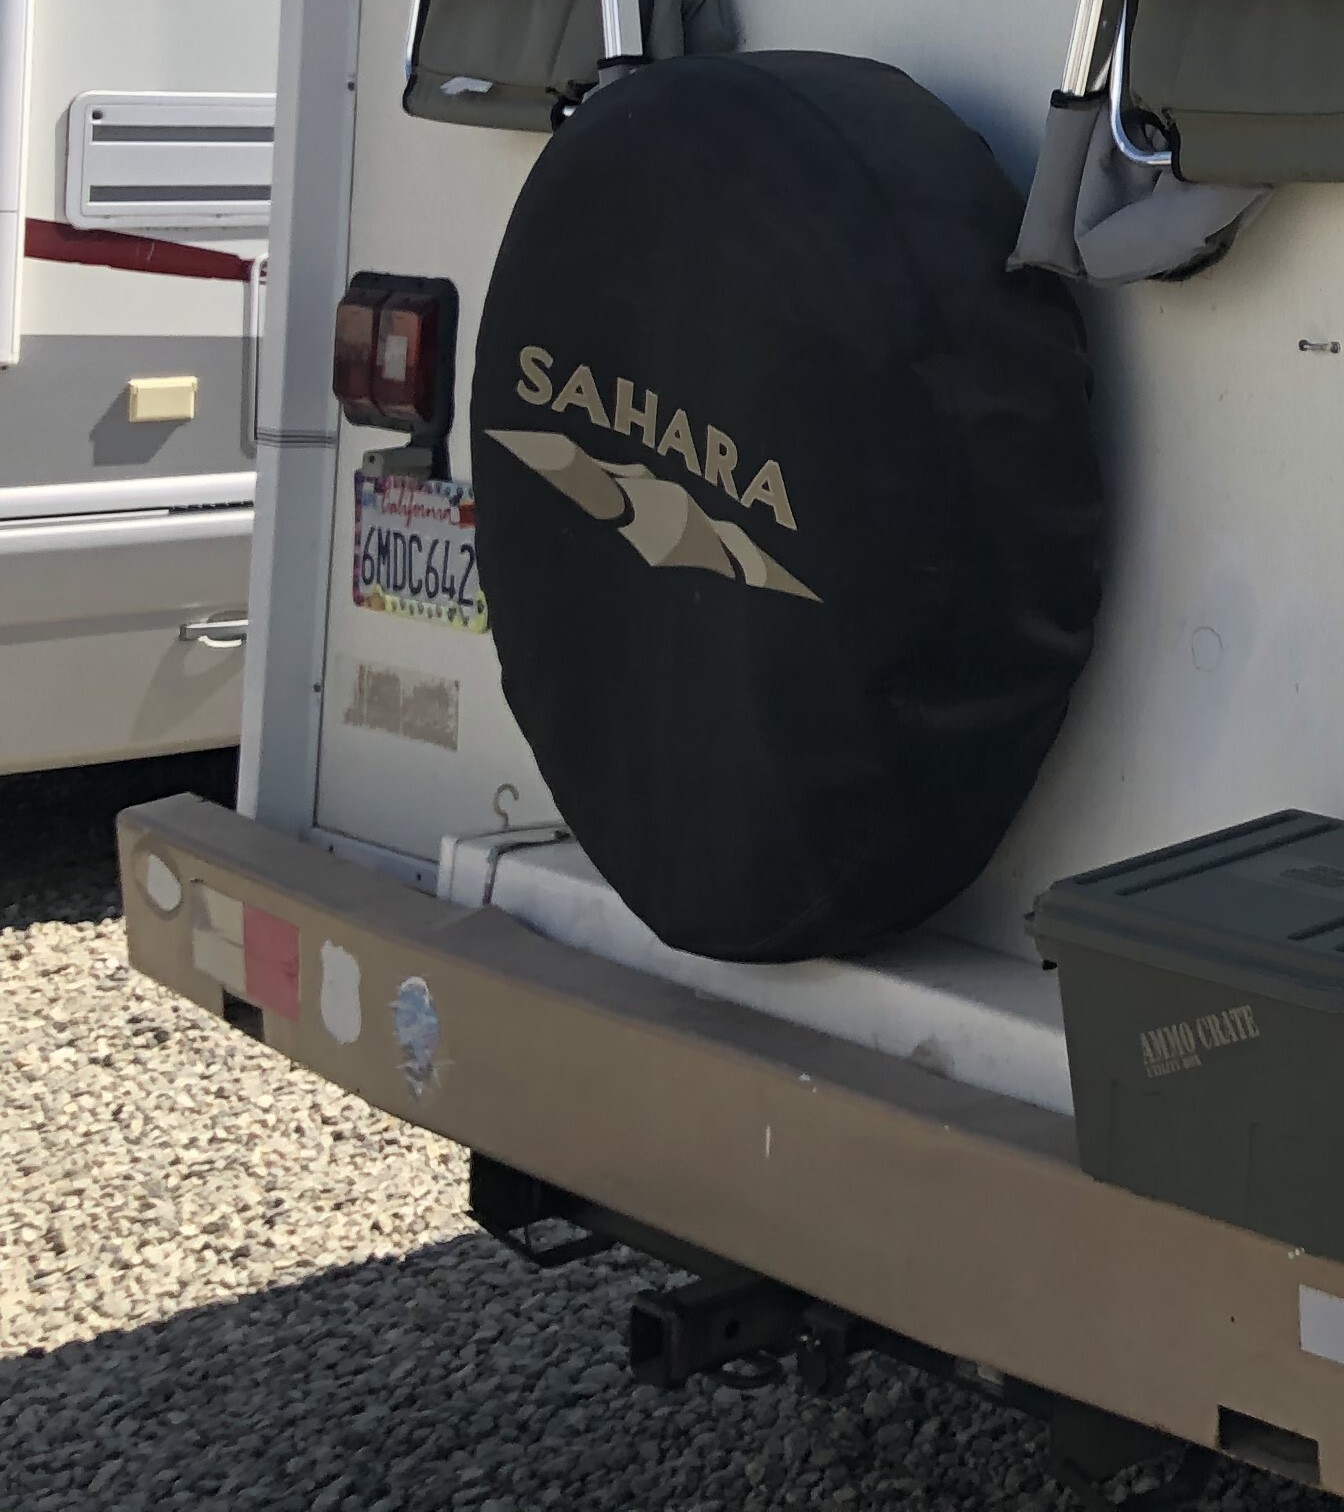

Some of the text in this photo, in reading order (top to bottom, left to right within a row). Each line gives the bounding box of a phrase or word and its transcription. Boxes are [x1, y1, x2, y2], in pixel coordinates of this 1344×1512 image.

[516, 345, 798, 531] SAHARA
[381, 489, 456, 527] California
[361, 526, 475, 606] 6MDC642
[1141, 1004, 1260, 1066] AMMO CRATE
